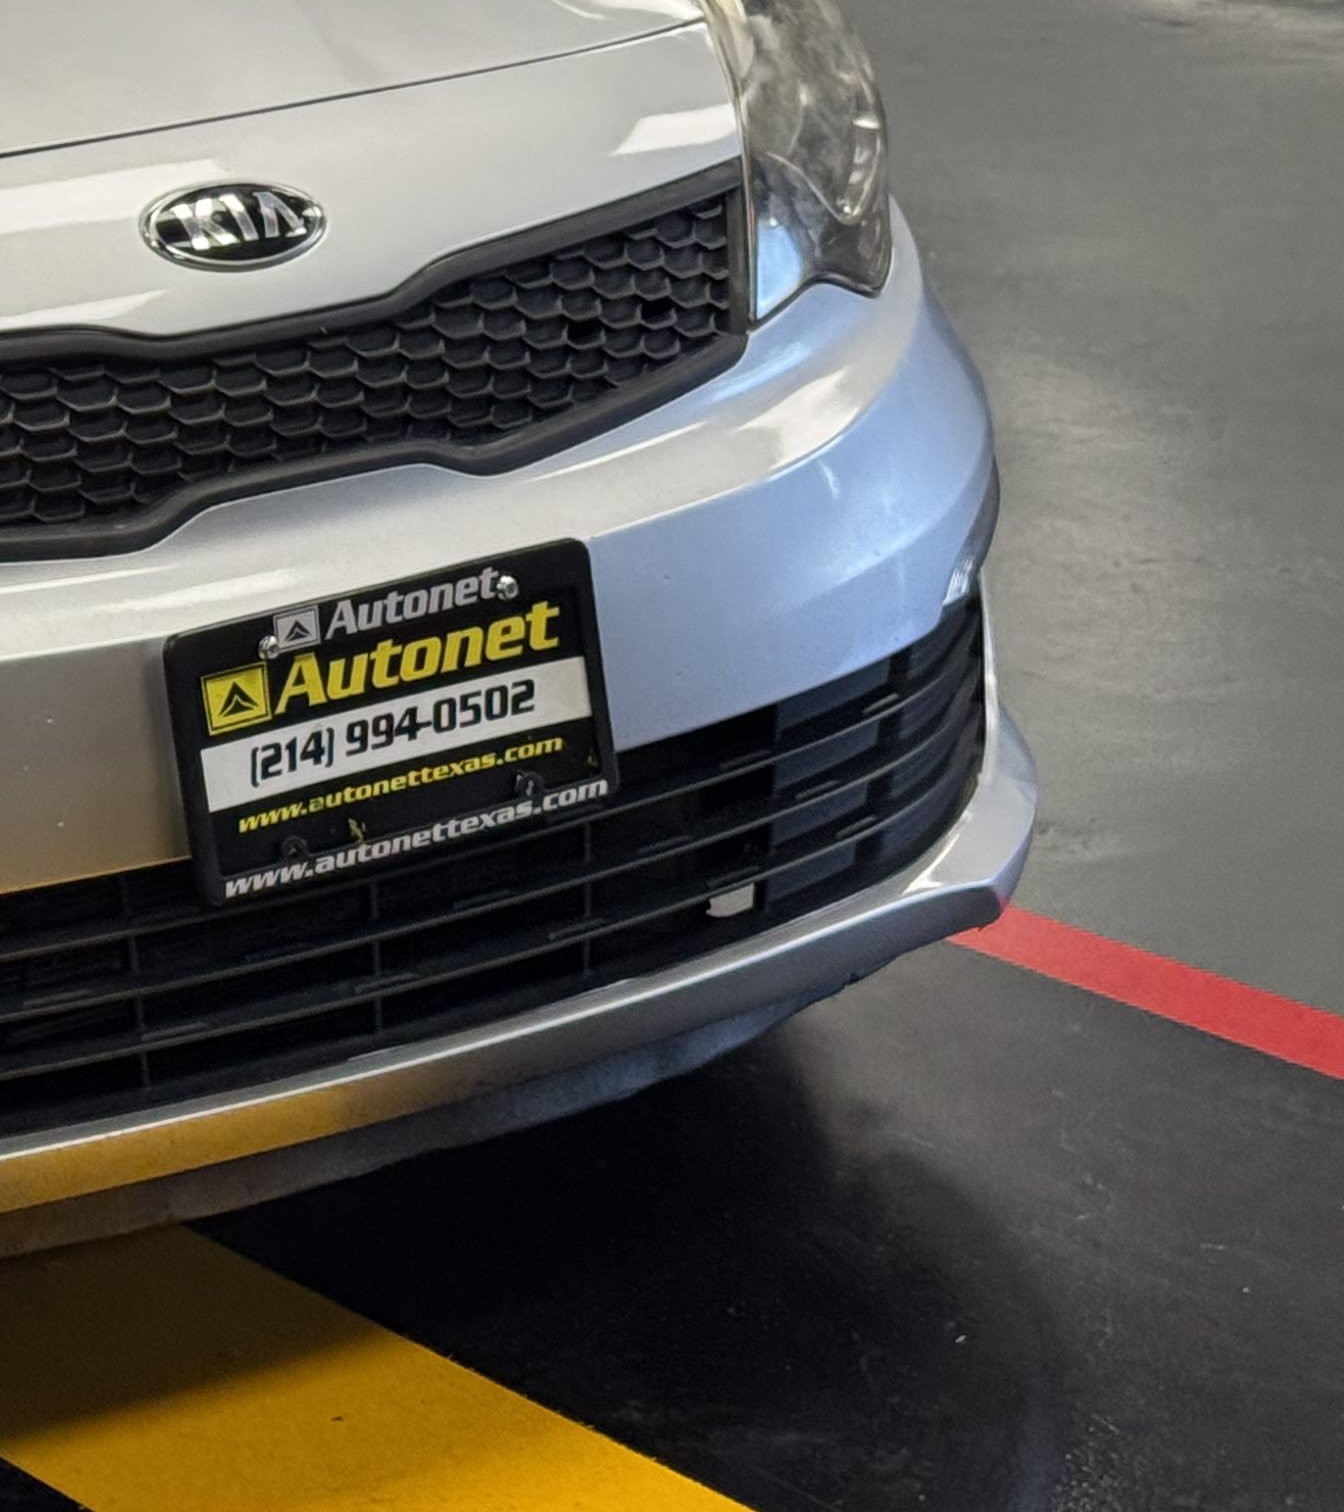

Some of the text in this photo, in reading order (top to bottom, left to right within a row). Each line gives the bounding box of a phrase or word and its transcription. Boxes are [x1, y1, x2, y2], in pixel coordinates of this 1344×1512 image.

[170, 191, 308, 251] KIA
[325, 567, 500, 640] Autonet
[273, 600, 560, 715] Autonet
[238, 736, 564, 834] www.autonettexas.com
[250, 678, 535, 788] (214) 994-0502
[223, 779, 609, 899] www.autonettexas.com
